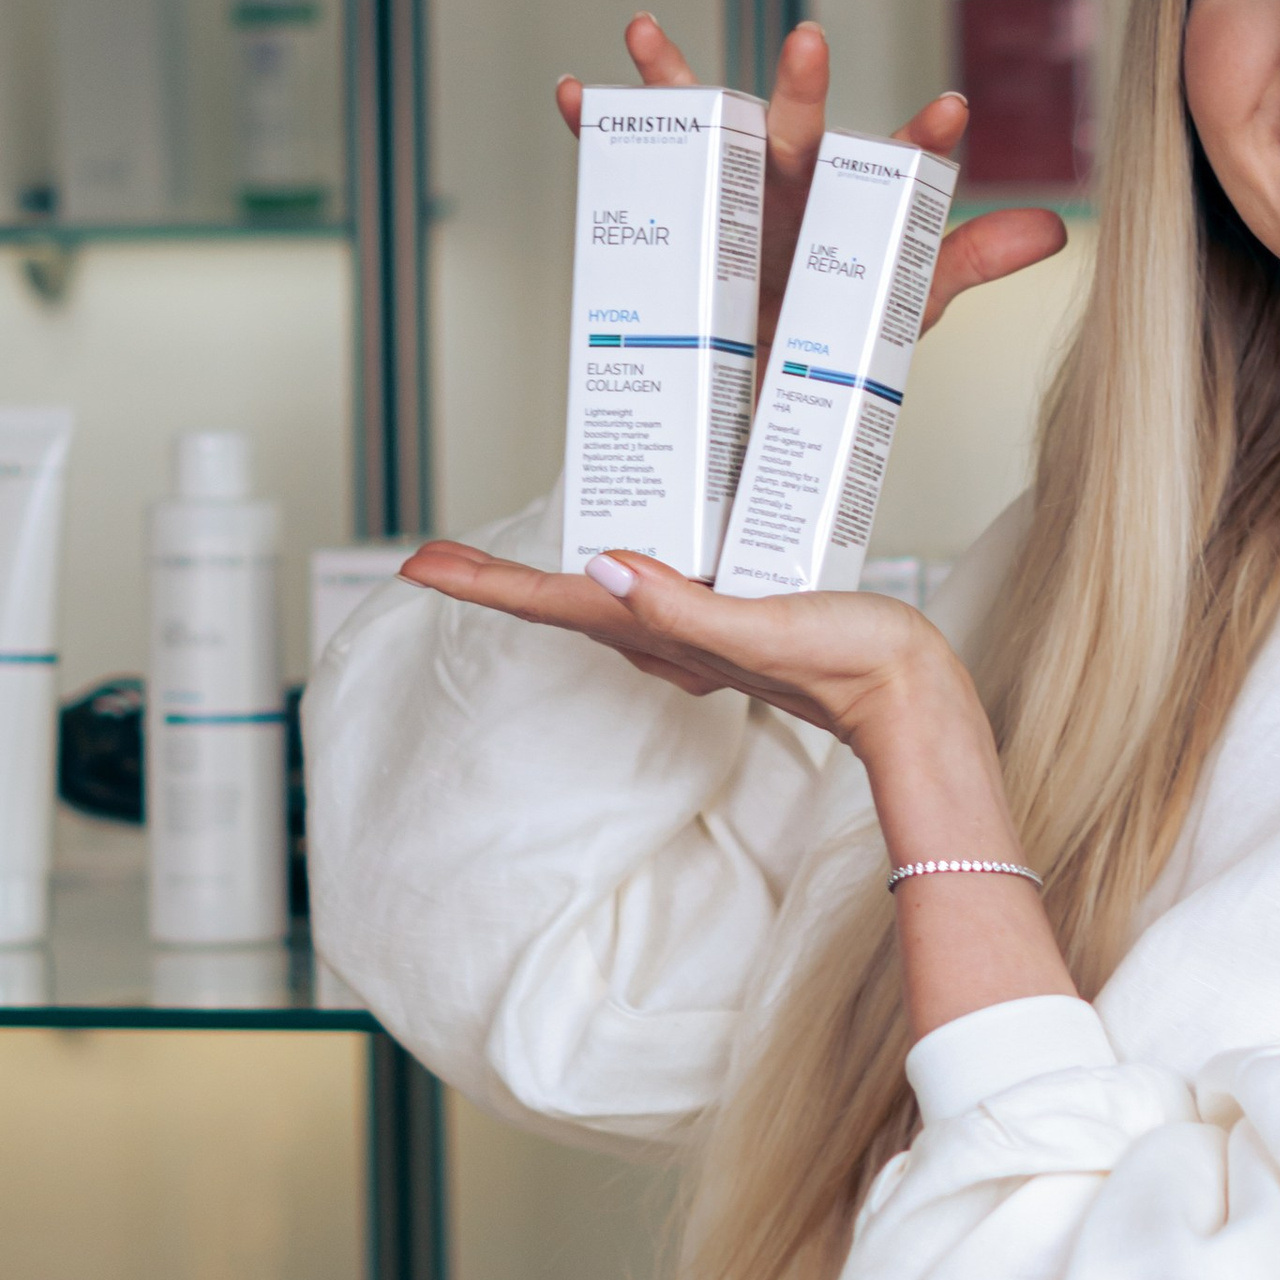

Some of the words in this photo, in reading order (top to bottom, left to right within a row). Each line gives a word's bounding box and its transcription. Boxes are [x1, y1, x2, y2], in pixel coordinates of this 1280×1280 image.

[598, 116, 701, 132] CHRISTINA
[610, 135, 688, 145] professional
[832, 157, 900, 179] CHRISTINA
[593, 210, 629, 224] LINE
[592, 222, 670, 246] REPAIR
[810, 243, 839, 258] LINE
[807, 255, 866, 279] REPAIR
[588, 310, 640, 322] HYDRA
[787, 338, 830, 355] HYDRA
[587, 363, 644, 375] ELASTIN
[586, 379, 662, 392] COLLAGEN
[776, 388, 833, 408] THERASKIN
[584, 408, 633, 418] Lightweight
[584, 420, 633, 429] moisturizing
[768, 422, 801, 435] Powerful
[584, 431, 619, 440] boosting
[638, 443, 673, 451] fractions
[763, 445, 789, 455] intense
[807, 443, 822, 451] and
[583, 453, 624, 462] hyaluronic
[760, 455, 792, 467] moisture
[582, 464, 608, 472] Works
[620, 465, 654, 473] diminish
[582, 476, 613, 484] visibility
[804, 473, 813, 481] for
[753, 484, 786, 498] Performs
[781, 481, 800, 491] dewy
[636, 489, 666, 497] leaving
[744, 517, 759, 525] and
[760, 520, 787, 530] smooth
[780, 514, 806, 524] volume
[740, 538, 754, 546] and
[782, 534, 800, 545] lines
